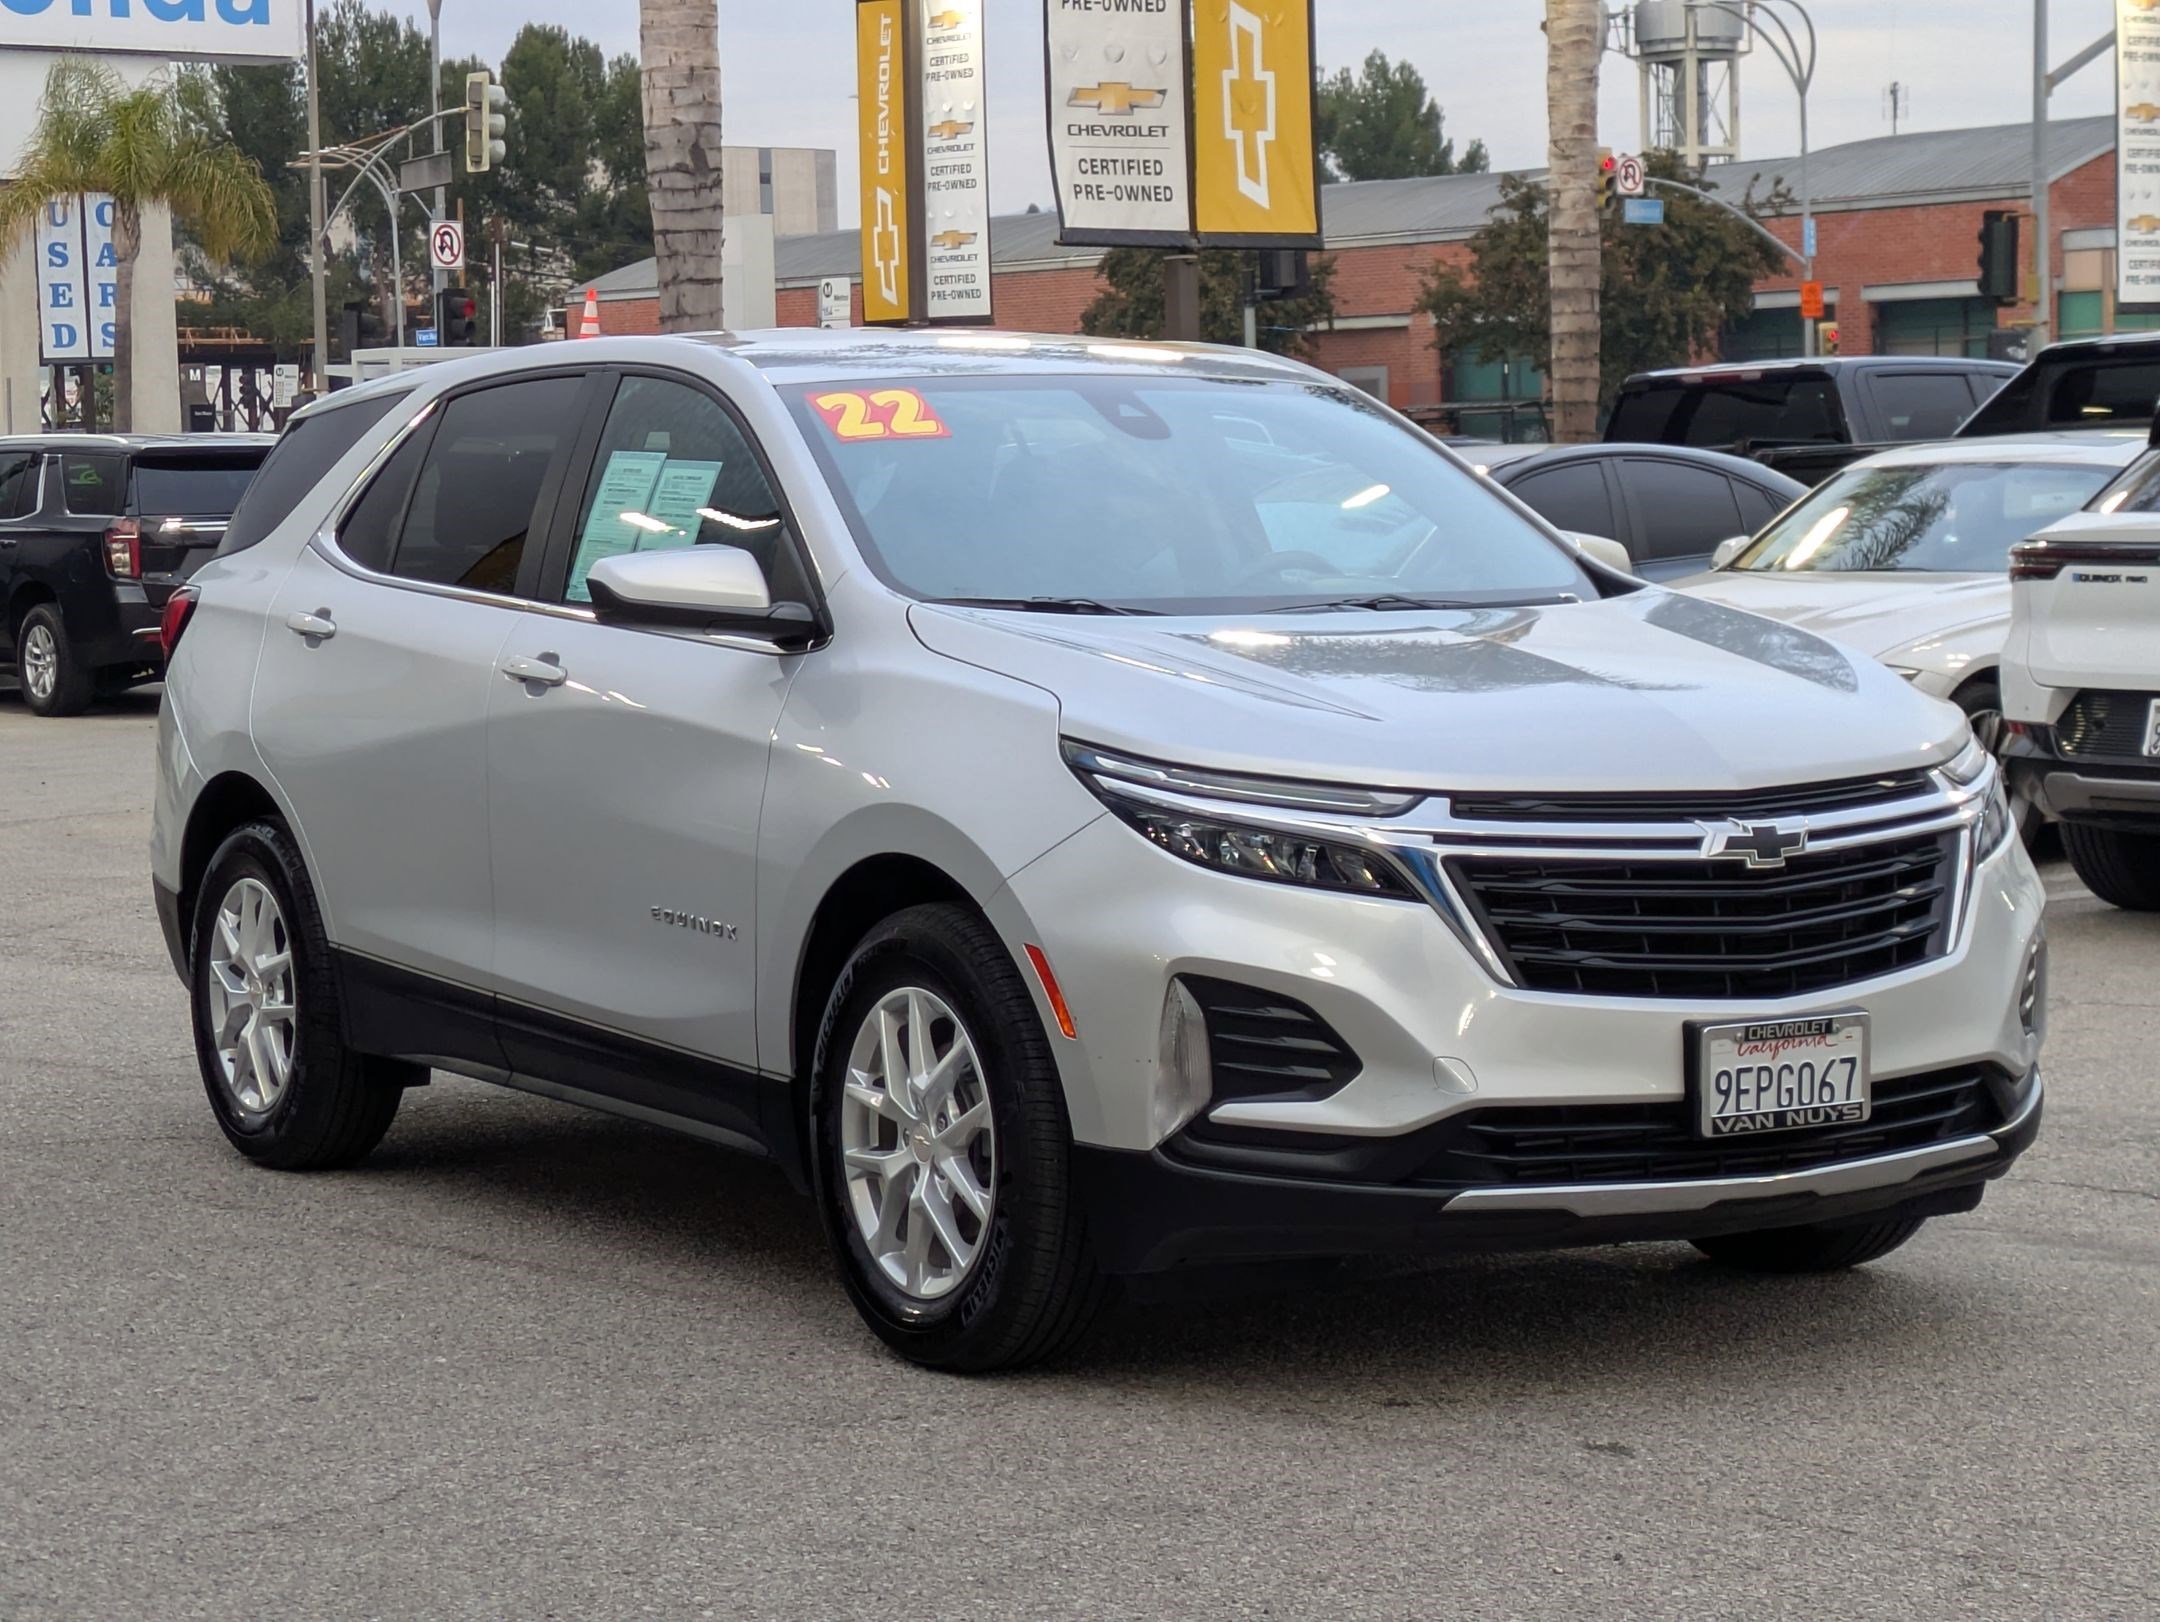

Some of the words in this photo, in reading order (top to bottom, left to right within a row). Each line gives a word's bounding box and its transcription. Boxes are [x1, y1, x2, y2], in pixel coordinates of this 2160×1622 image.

[1061, 0, 1166, 12] PRE-OWNED
[926, 33, 971, 45] CHEVROLET
[930, 53, 969, 67] CERTIFIED
[926, 68, 974, 81] PRE-OWNED
[878, 13, 891, 174] CHEVROLET
[1067, 124, 1169, 137] CHEVROLET
[927, 143, 975, 155] CHEVROLET
[930, 164, 972, 176] CERTIFIED
[1078, 158, 1163, 176] CERTIFIED
[928, 178, 977, 191] PRE-OWNED
[1073, 184, 1173, 202] PRE-OWNED
[930, 253, 978, 264] CHEVROLET
[48, 201, 77, 348] USED
[95, 201, 118, 348] CARS
[934, 274, 976, 286] CERTIFIED
[931, 288, 981, 300] PRE-OWNED
[189, 368, 201, 381] M
[815, 390, 943, 438] 22
[650, 905, 738, 941] EQUINOX
[1748, 1020, 1829, 1040] CHEVROLET
[1737, 1034, 1838, 1061] California
[1715, 1057, 1857, 1114] 9EPG067
[1715, 1115, 1775, 1133] VAN
